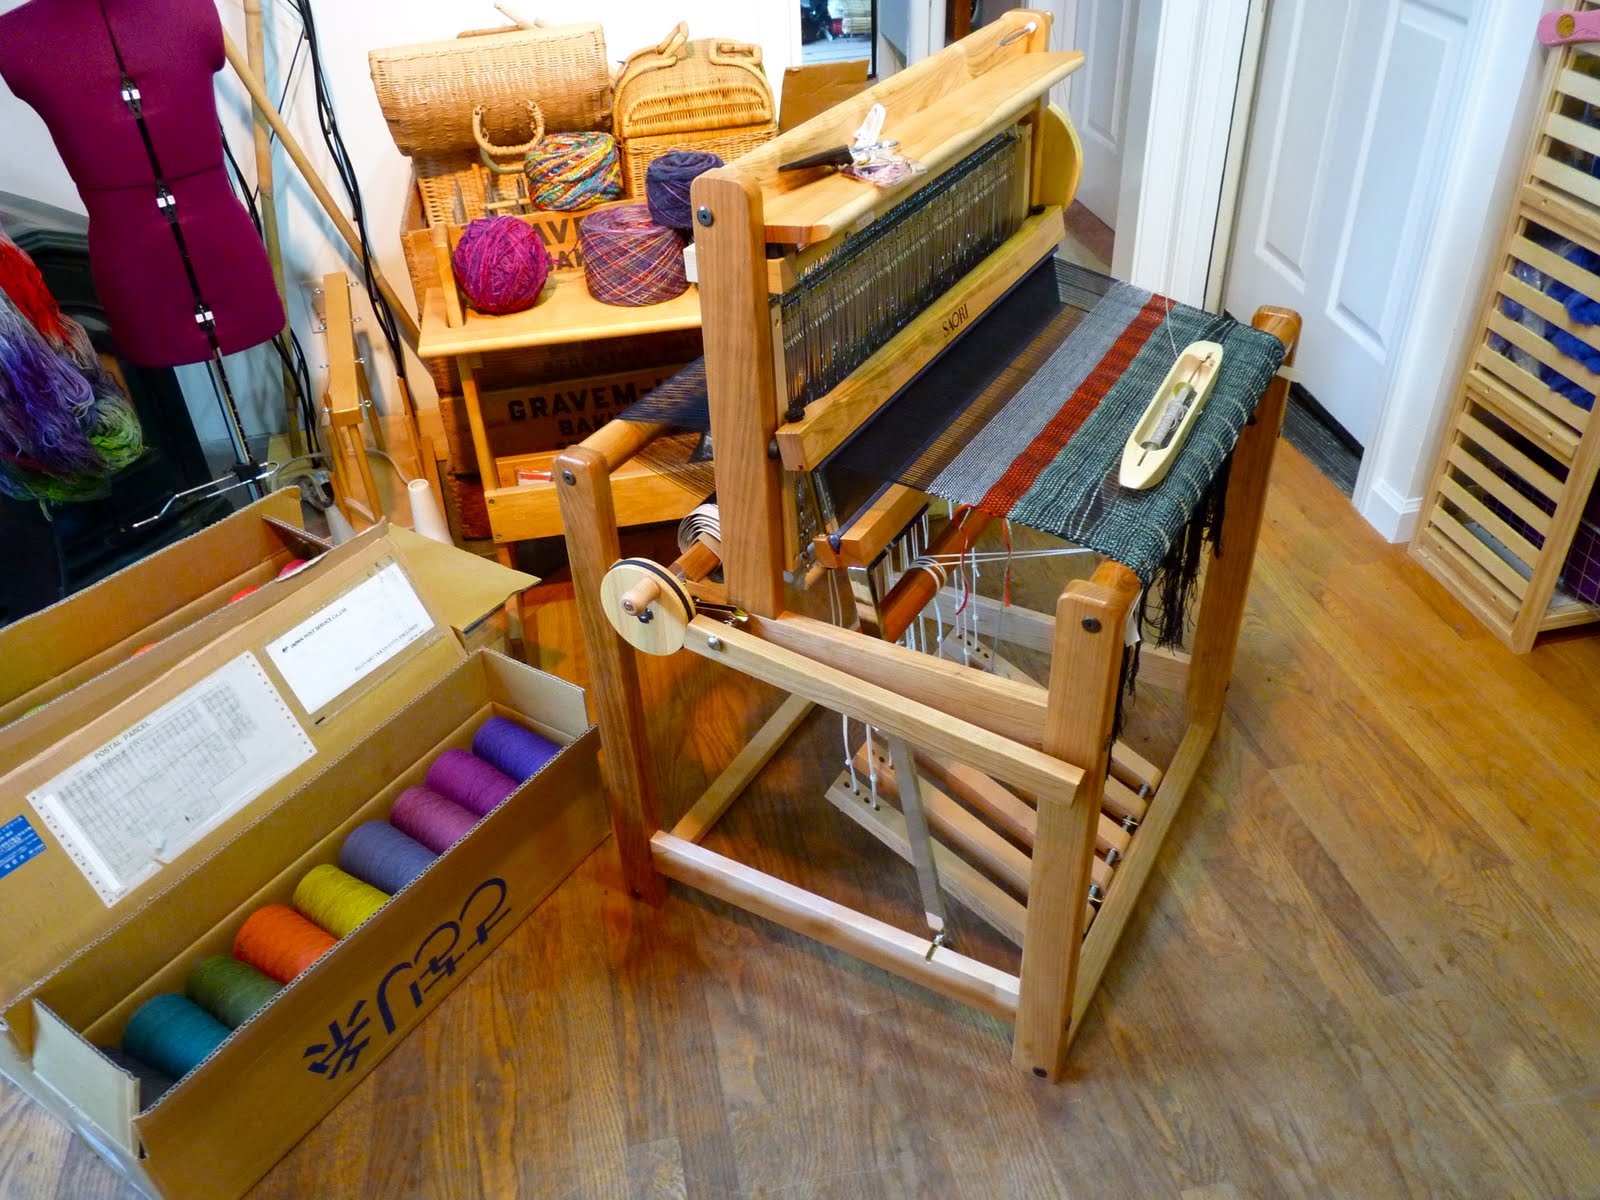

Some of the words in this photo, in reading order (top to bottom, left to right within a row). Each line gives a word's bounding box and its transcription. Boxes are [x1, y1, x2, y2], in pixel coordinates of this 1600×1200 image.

[942, 303, 969, 338] SAORI
[508, 377, 668, 422] GRAVEM-
[290, 637, 304, 649] JAPAN
[303, 629, 315, 639] POST
[315, 617, 332, 631] SERVICE
[94, 740, 122, 760] POSTAL
[122, 720, 152, 741] PARCEL
[302, 877, 512, 1081] さをり糸
